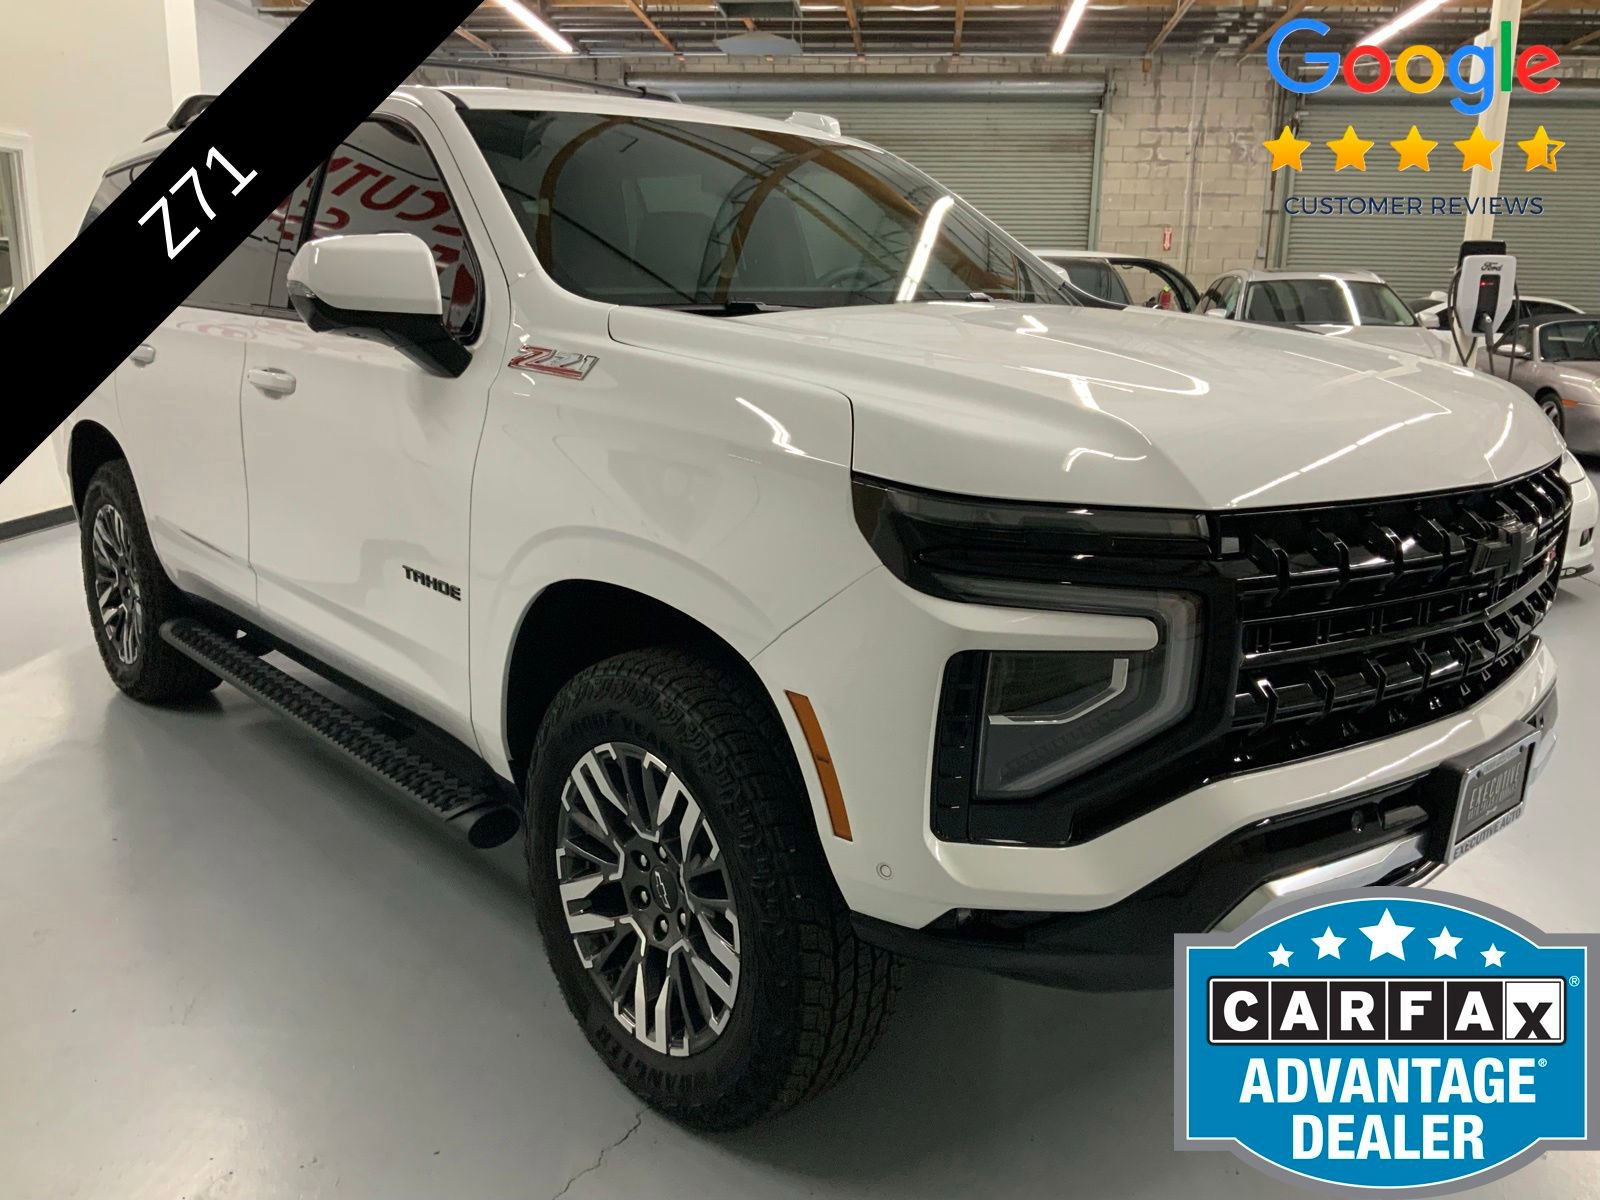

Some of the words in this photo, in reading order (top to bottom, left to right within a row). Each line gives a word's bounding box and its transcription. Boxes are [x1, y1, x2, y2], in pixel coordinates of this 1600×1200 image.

[1480, 261, 1503, 272] Ford
[507, 344, 600, 382] Z71
[402, 564, 462, 602] TAHOE
[1453, 826, 1500, 859] EXECUTIVE
